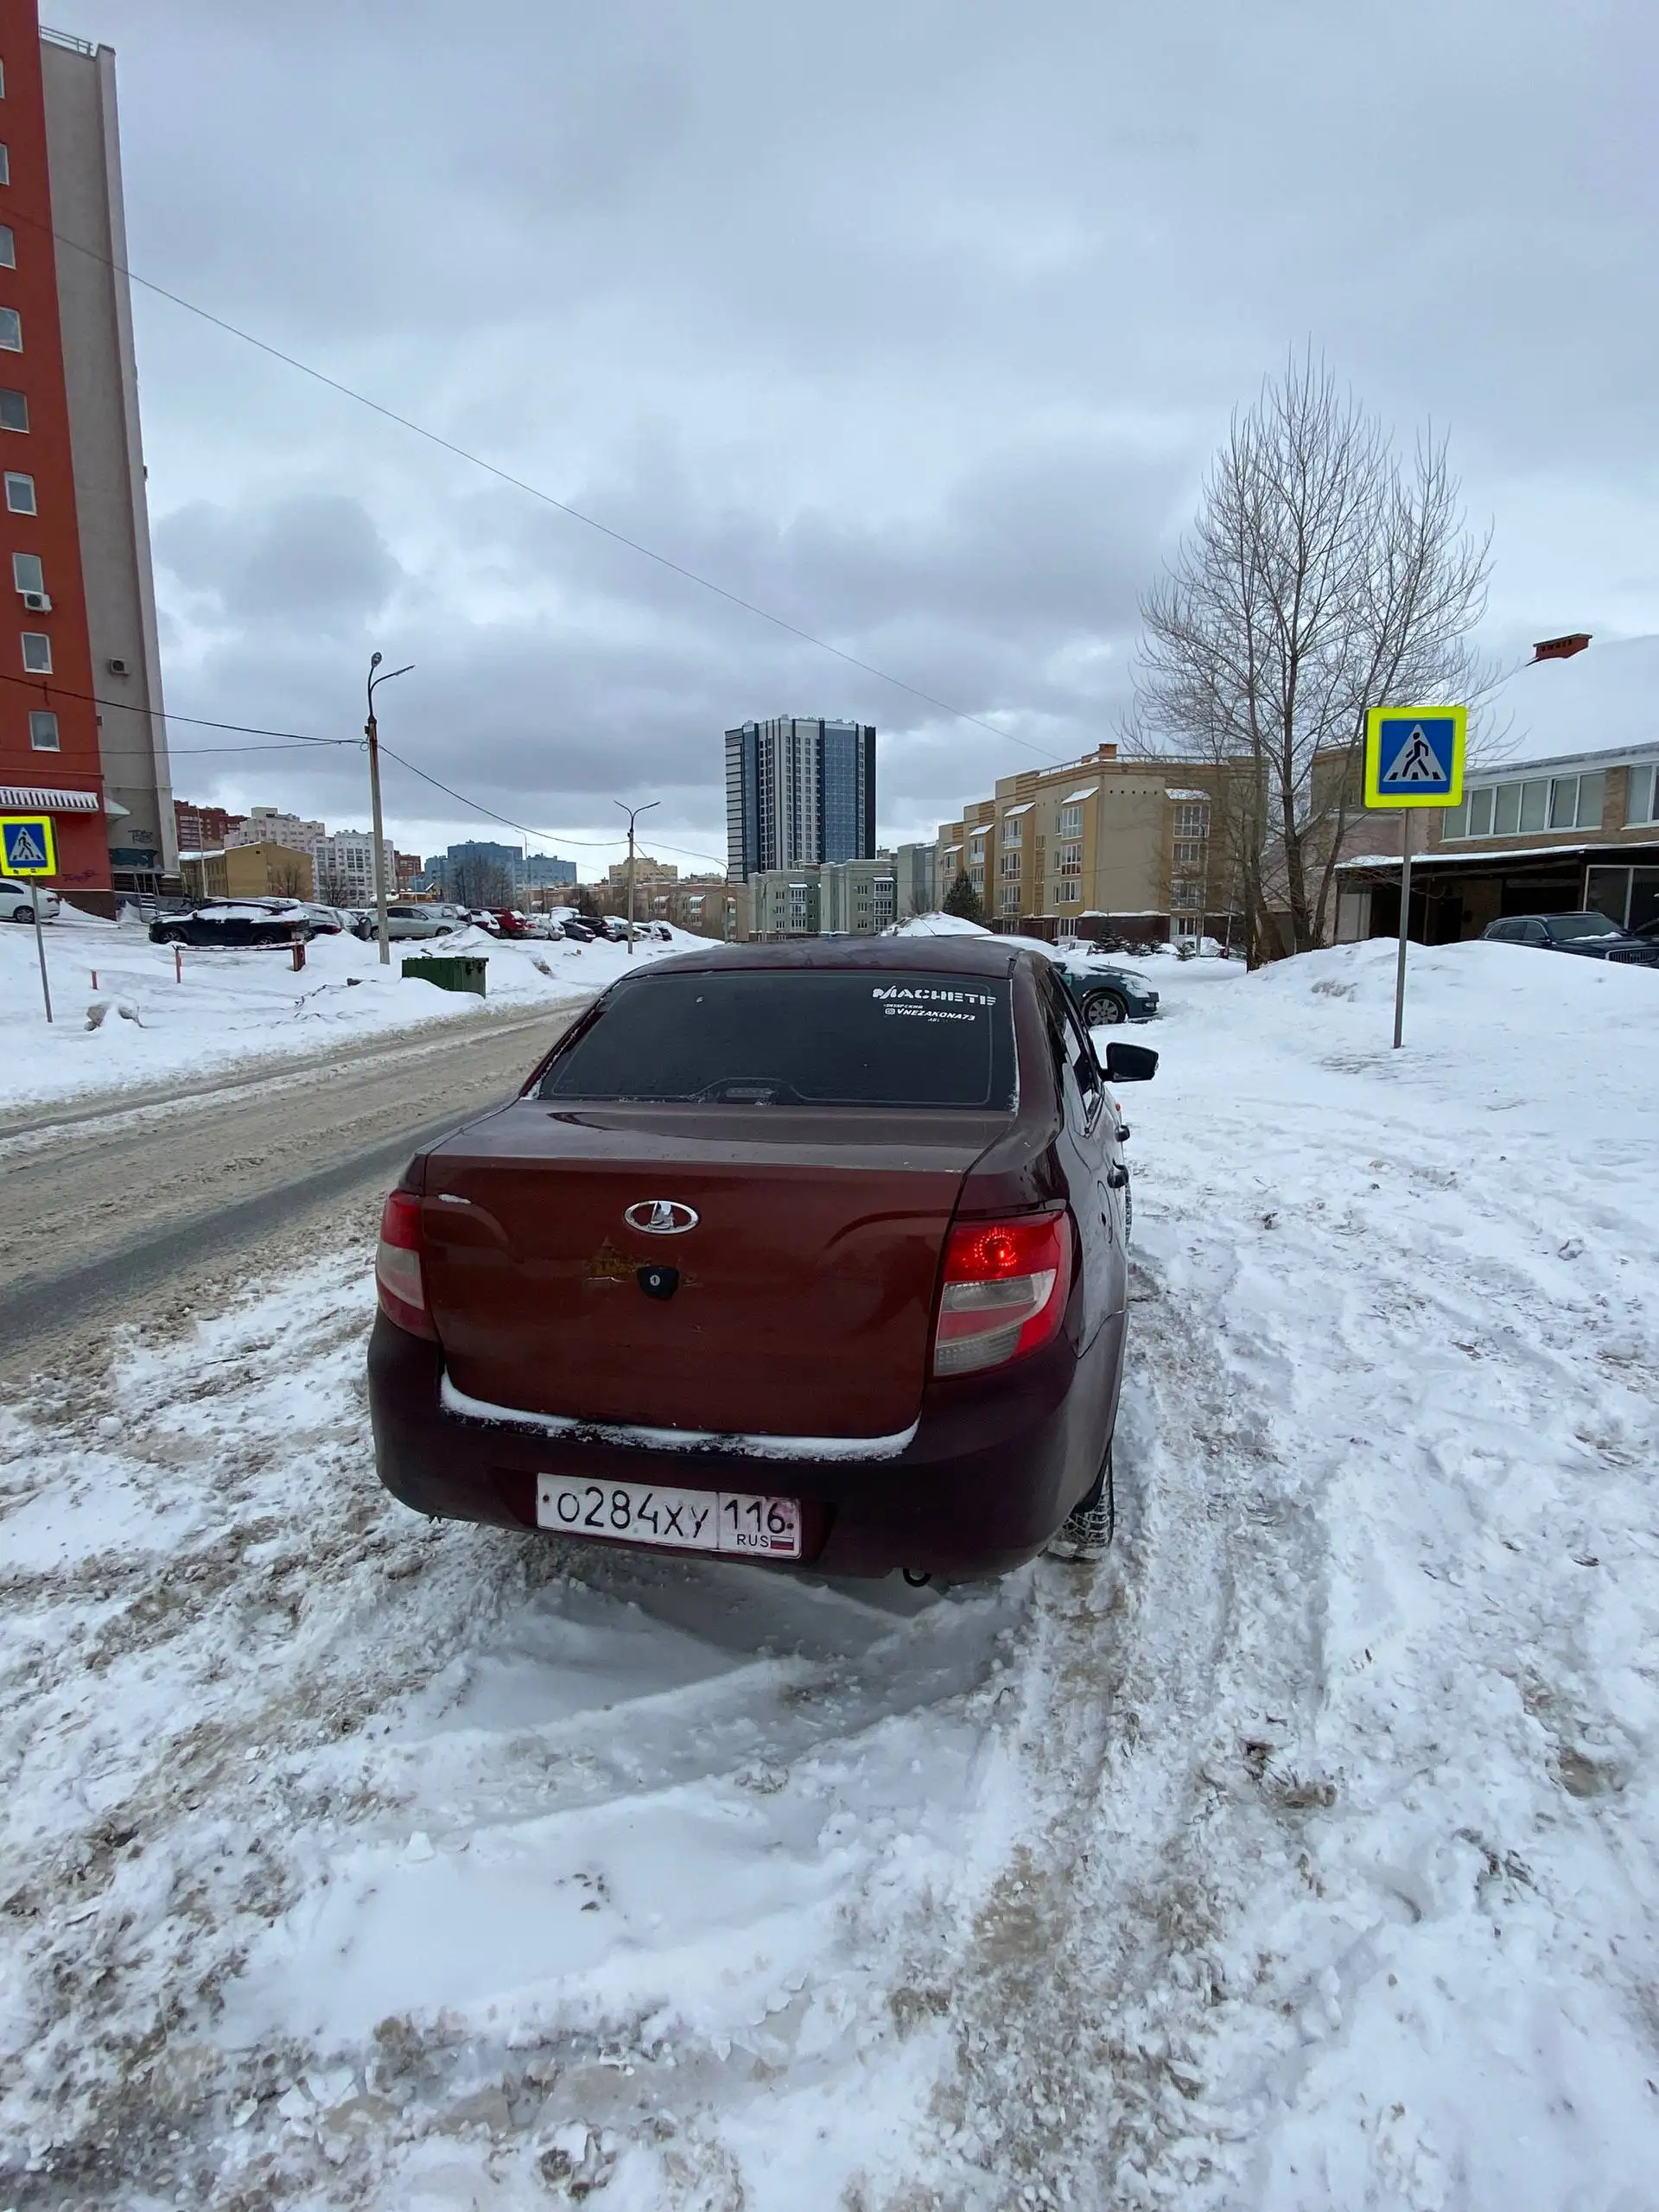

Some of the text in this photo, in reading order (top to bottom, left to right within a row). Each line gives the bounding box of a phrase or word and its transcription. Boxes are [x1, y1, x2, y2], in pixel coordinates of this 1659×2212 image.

[873, 985, 996, 1006] MACHETE
[724, 1499, 785, 1534] 116
[736, 1533, 769, 1548] RUS
